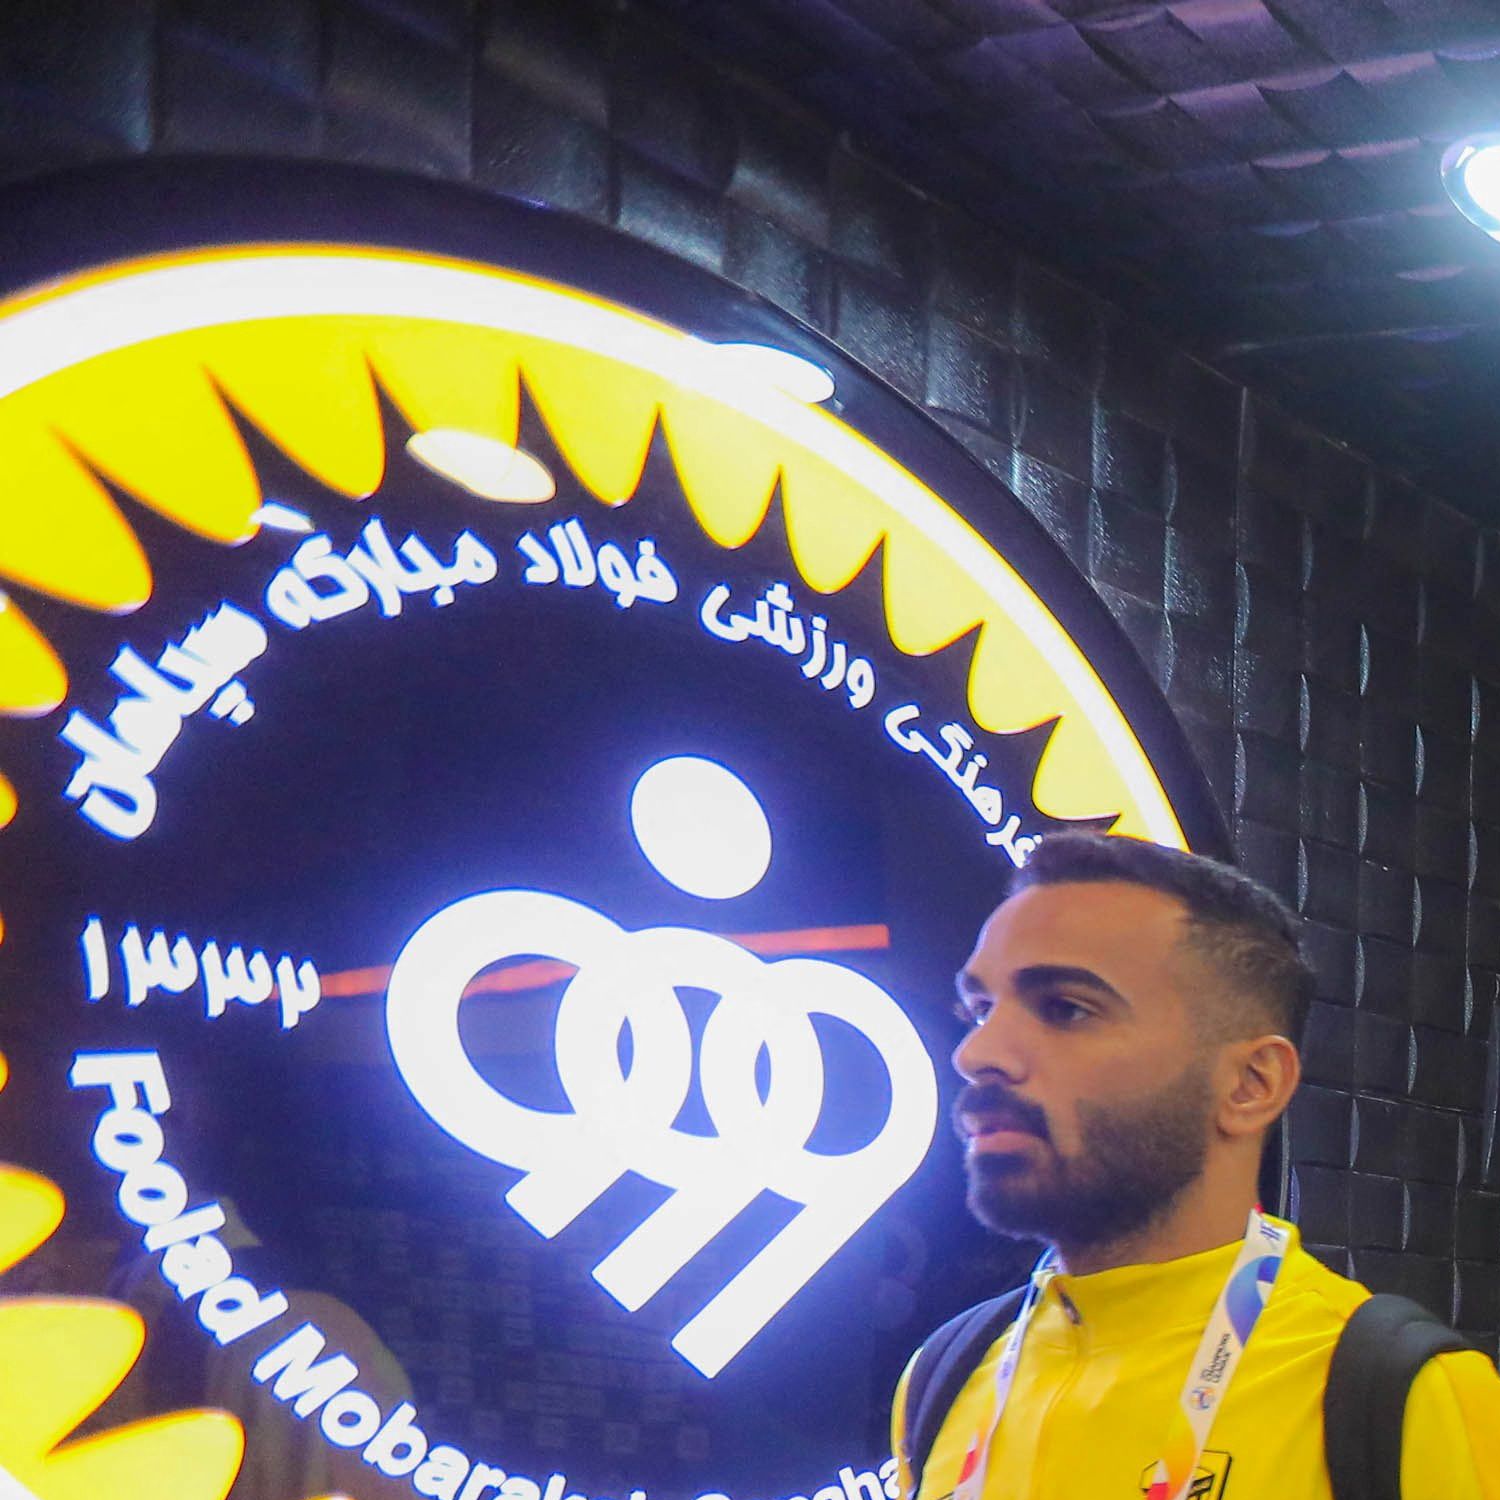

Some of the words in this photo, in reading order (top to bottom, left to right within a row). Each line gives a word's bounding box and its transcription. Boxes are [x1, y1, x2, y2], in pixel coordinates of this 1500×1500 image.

[517, 517, 679, 609] فولاد
[701, 583, 876, 709] ورزشی
[70, 1048, 288, 1346] Foolad
